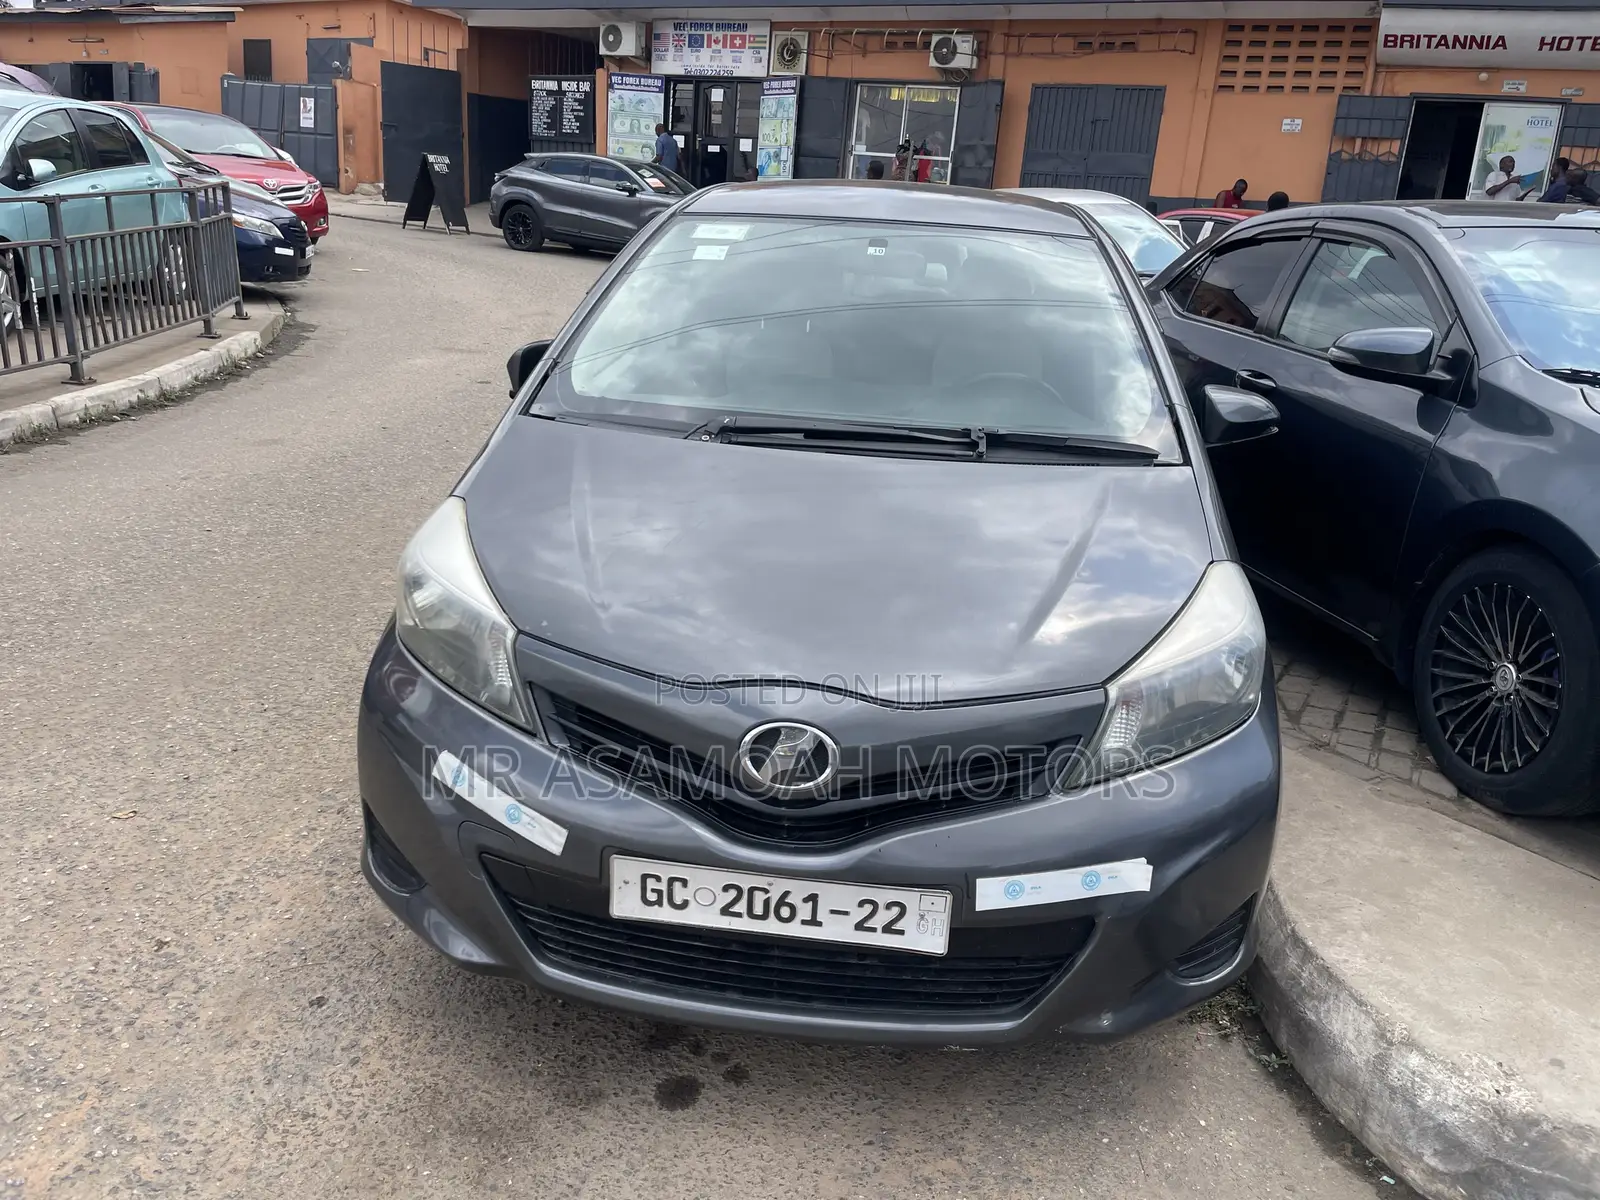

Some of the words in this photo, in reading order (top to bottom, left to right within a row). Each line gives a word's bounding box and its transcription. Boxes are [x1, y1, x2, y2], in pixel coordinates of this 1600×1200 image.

[673, 22, 688, 31] VEC
[690, 22, 714, 32] FOREX
[715, 22, 748, 32] BUREAU
[1383, 34, 1508, 50] BRITANNIA
[579, 81, 590, 92] BAR
[641, 78, 662, 86] BUREAU
[1527, 119, 1553, 127] HOTEL
[640, 872, 691, 911] GC
[719, 882, 907, 936] 2061-22
[916, 917, 944, 937] GH
